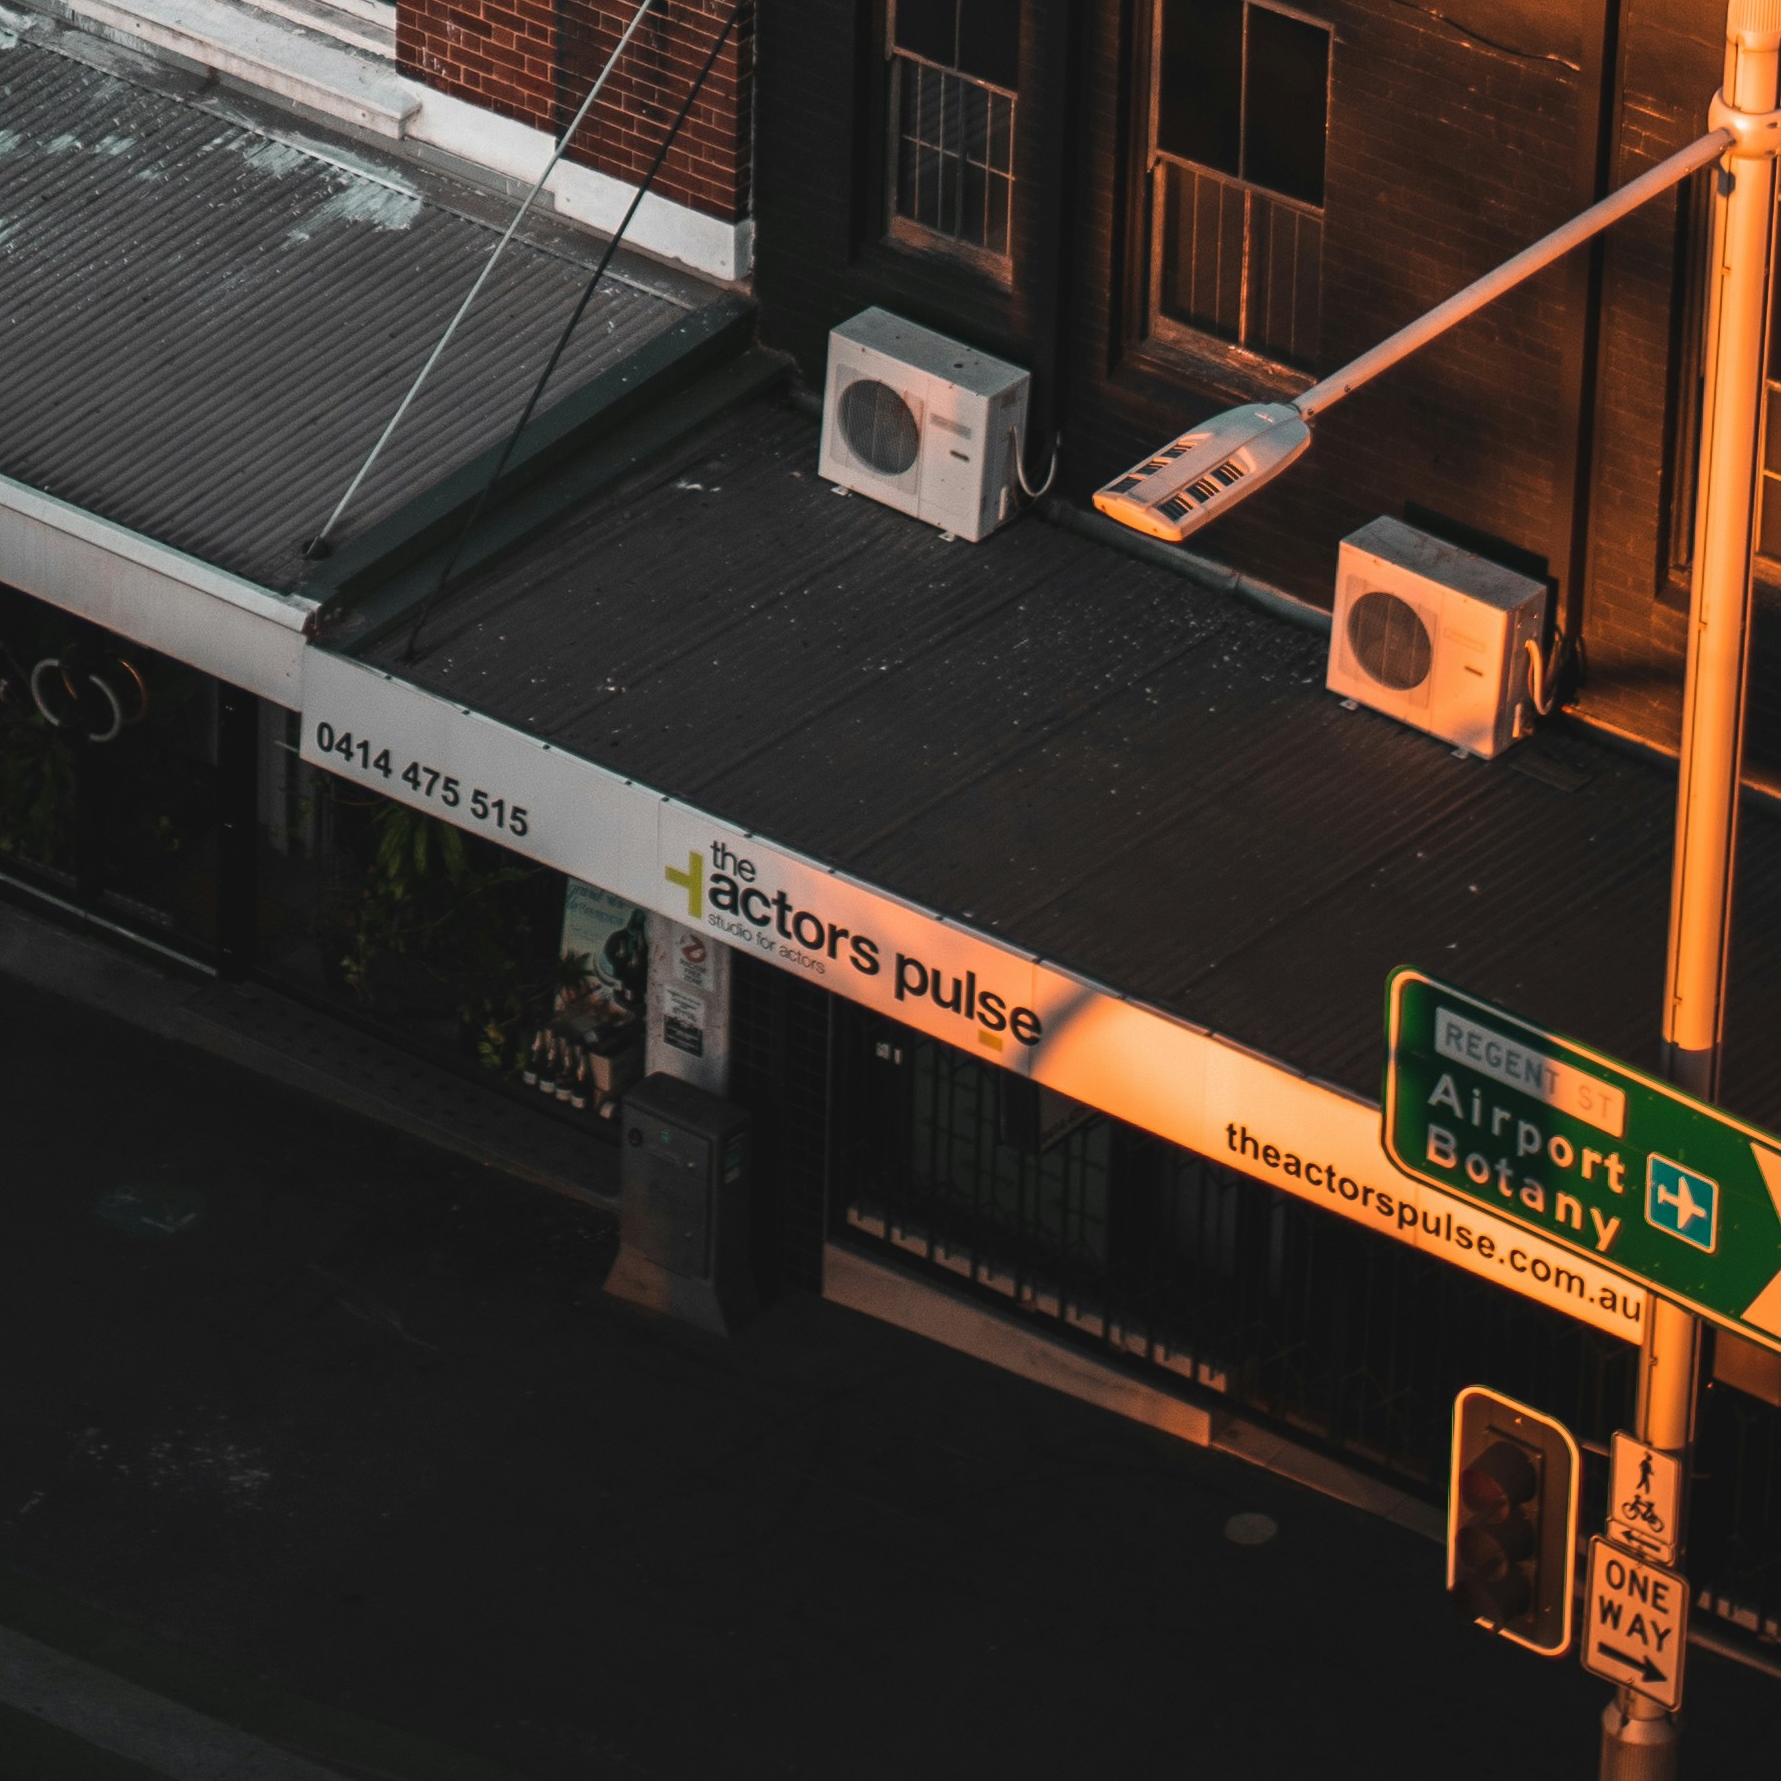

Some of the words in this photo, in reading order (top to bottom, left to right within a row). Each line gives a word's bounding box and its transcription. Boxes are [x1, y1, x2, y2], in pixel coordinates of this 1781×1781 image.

[316, 720, 393, 780] 0414
[401, 760, 461, 809] 475
[470, 790, 529, 837] 515
[710, 840, 756, 883] the
[708, 913, 753, 942] studio
[756, 931, 777, 952] for
[779, 945, 826, 975] actors
[708, 872, 880, 975] actors
[894, 951, 1043, 1047] pulse
[1445, 1021, 1560, 1095] REGENT
[1577, 1083, 1612, 1119] ST
[1427, 1073, 1626, 1195] Airport
[1224, 1121, 1642, 1324] theactorspulse.com.au
[1426, 1123, 1622, 1254] Botany
[1599, 1595, 1671, 1652] WAY
[1606, 1559, 1669, 1614] ONE
